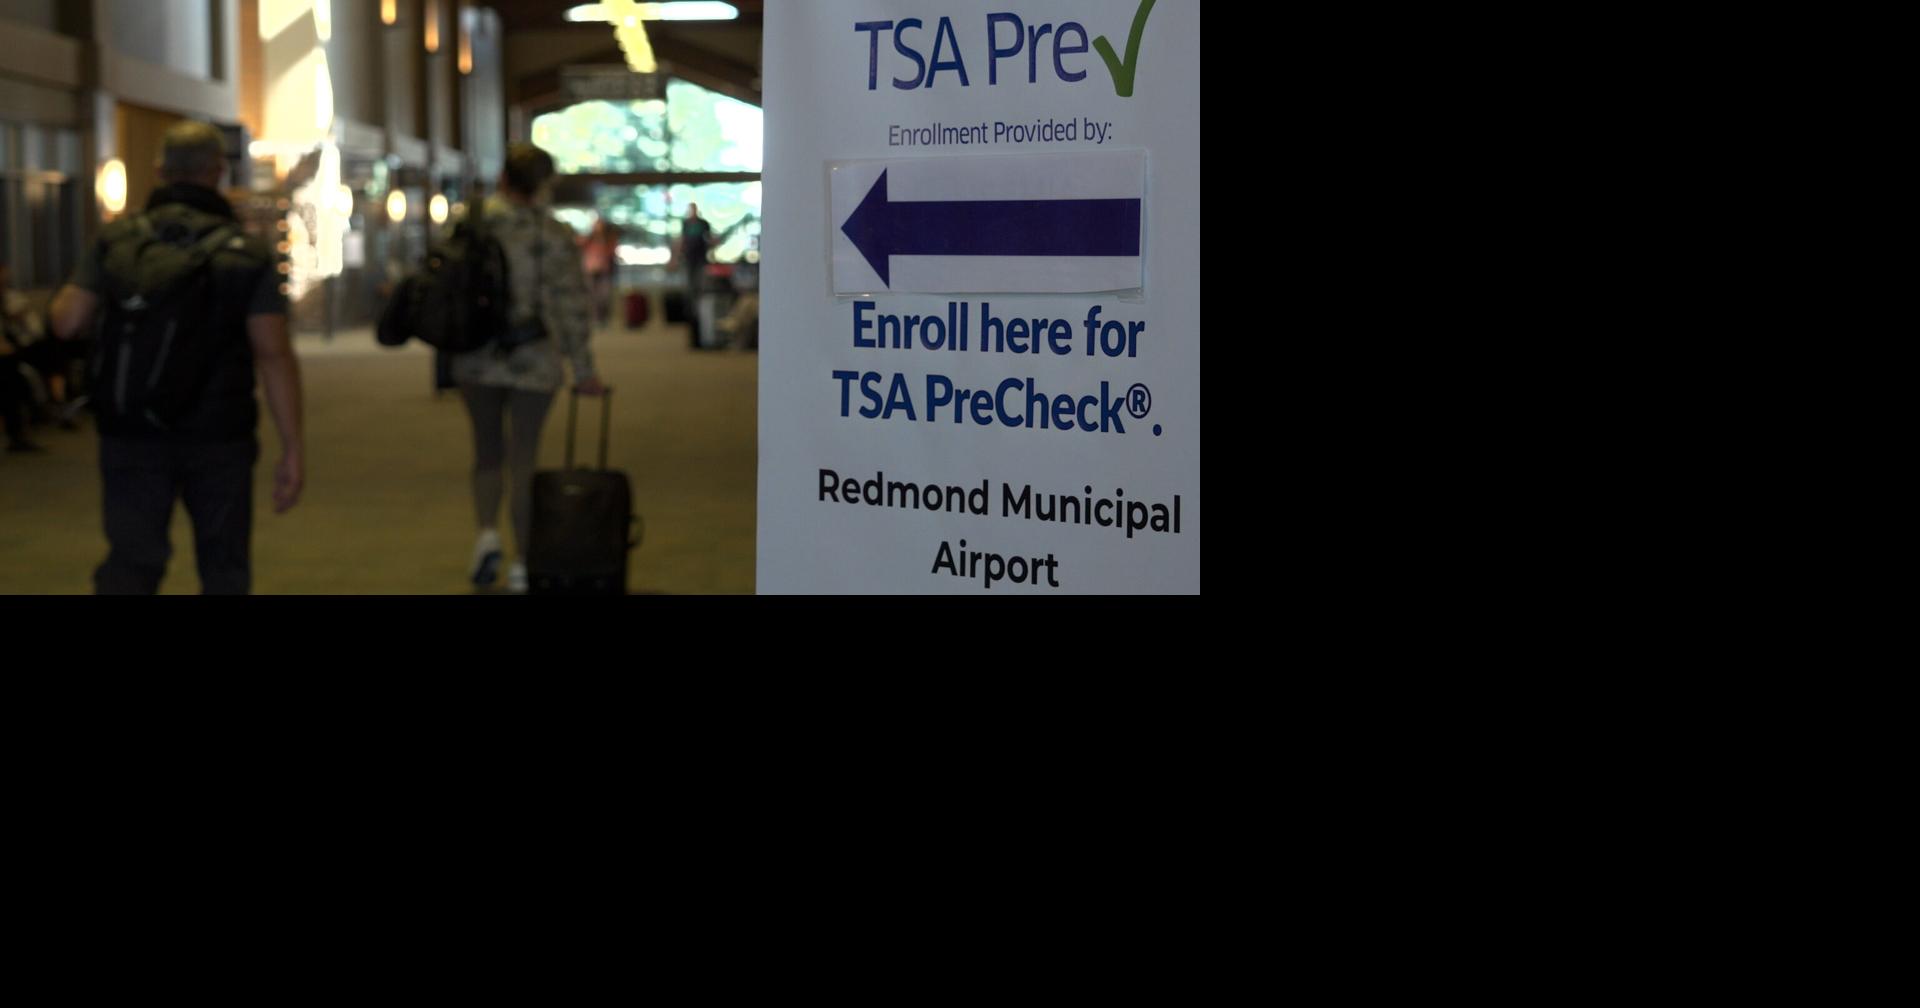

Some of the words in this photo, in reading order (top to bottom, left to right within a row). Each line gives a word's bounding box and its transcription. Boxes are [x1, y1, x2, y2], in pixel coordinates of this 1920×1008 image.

[855, 16, 969, 90] TSA
[987, 12, 1088, 85] Pre
[890, 123, 988, 145] Enrollment
[995, 118, 1076, 143] Provided
[1084, 118, 1111, 144] by:
[853, 301, 968, 351] Enroll
[981, 303, 1072, 355] here
[1084, 305, 1145, 357] for
[832, 370, 916, 421] TSA
[819, 469, 988, 515] Redmond
[1003, 483, 1180, 538] Municipal
[932, 539, 1059, 588] Airport
